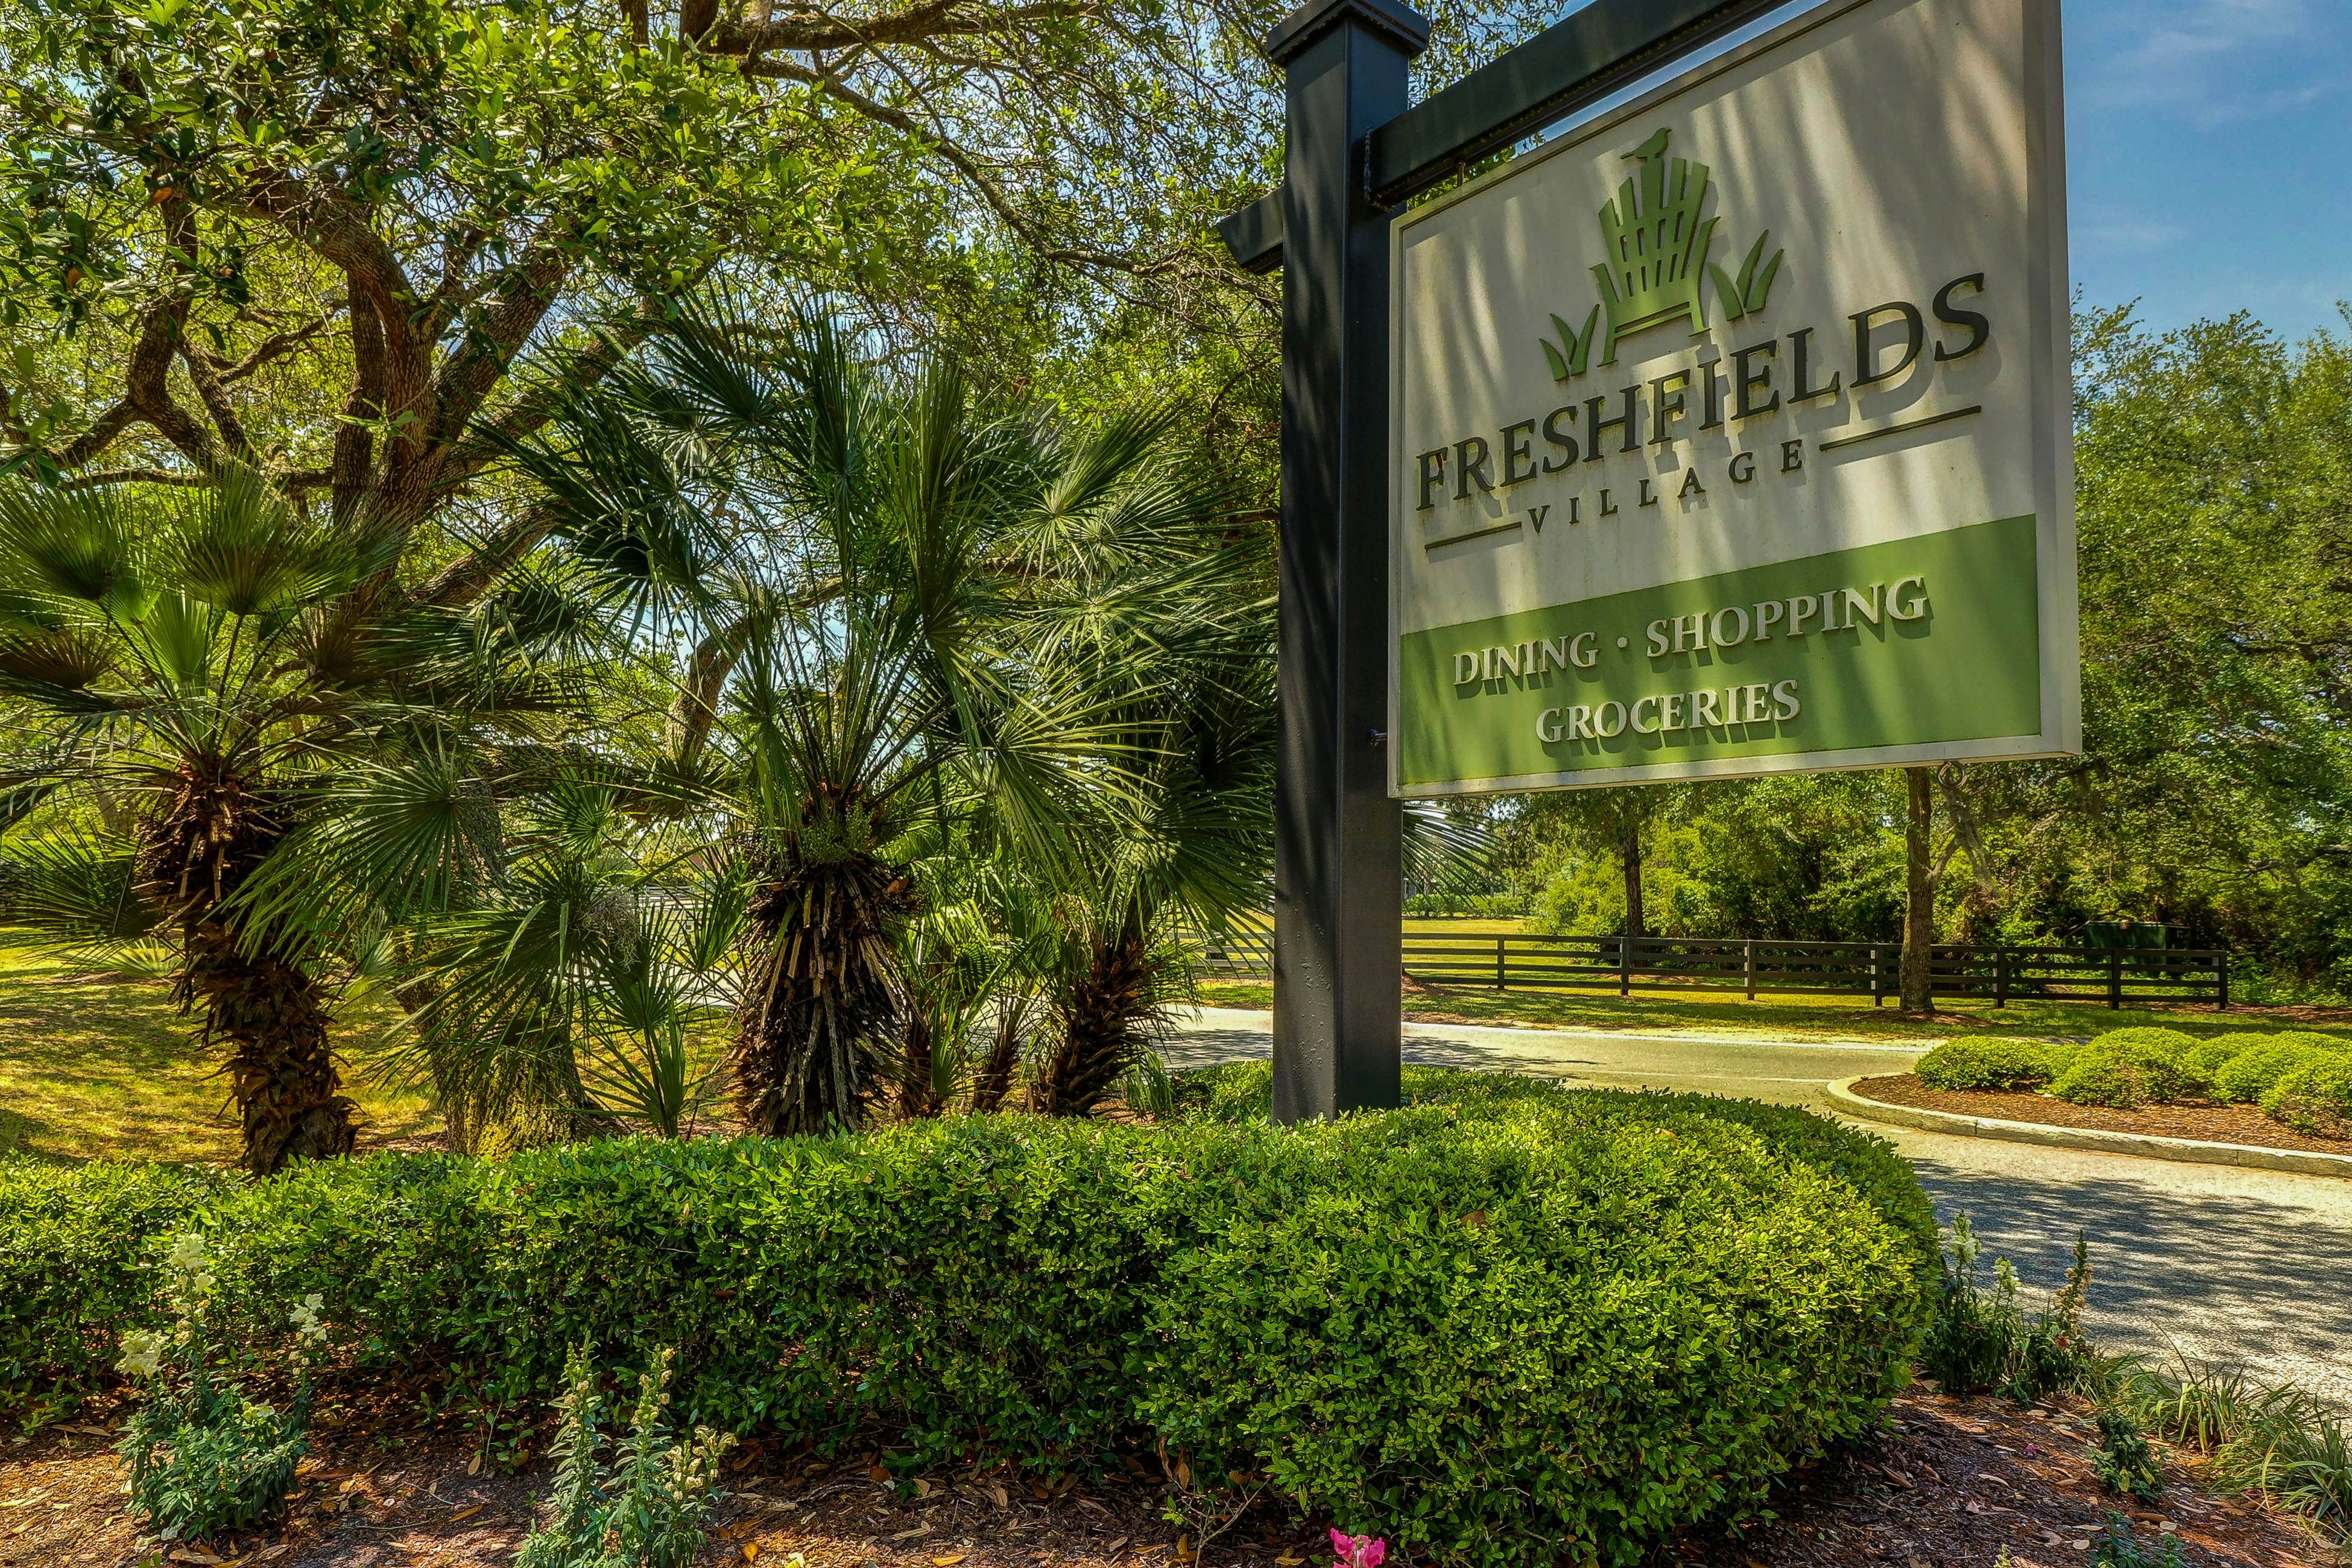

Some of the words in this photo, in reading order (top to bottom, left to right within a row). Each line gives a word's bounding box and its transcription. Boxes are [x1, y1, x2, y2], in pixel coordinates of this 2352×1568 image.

[1415, 272, 1990, 511] FRESHFIELDS
[1527, 439, 1803, 533] VILLAGE
[1452, 631, 1599, 686] DINING
[1646, 575, 1927, 658] SHOPPING
[1535, 679, 1801, 744] GROCERIES
